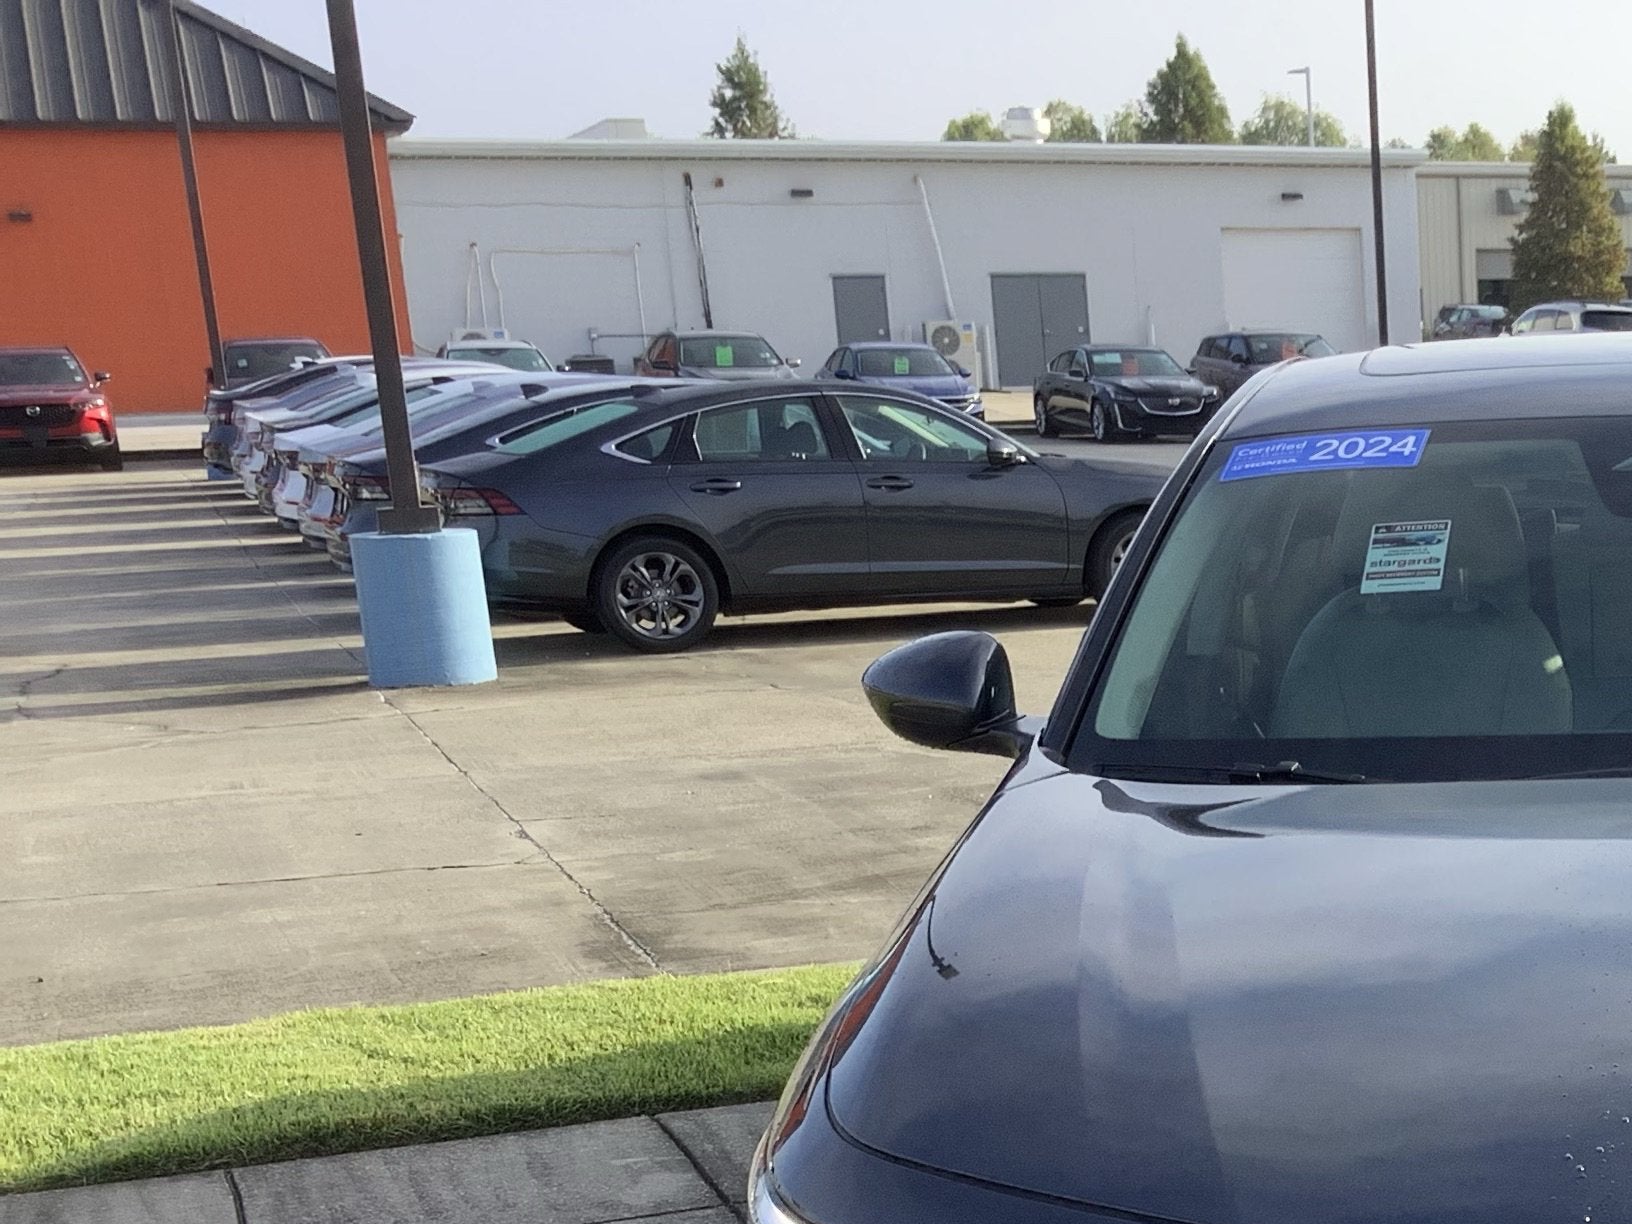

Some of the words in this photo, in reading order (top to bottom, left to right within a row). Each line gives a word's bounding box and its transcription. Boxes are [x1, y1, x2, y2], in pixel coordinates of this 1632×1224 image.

[1238, 441, 1308, 457] Certified
[1309, 435, 1417, 461] 2024
[1395, 523, 1446, 532] ATTENTION
